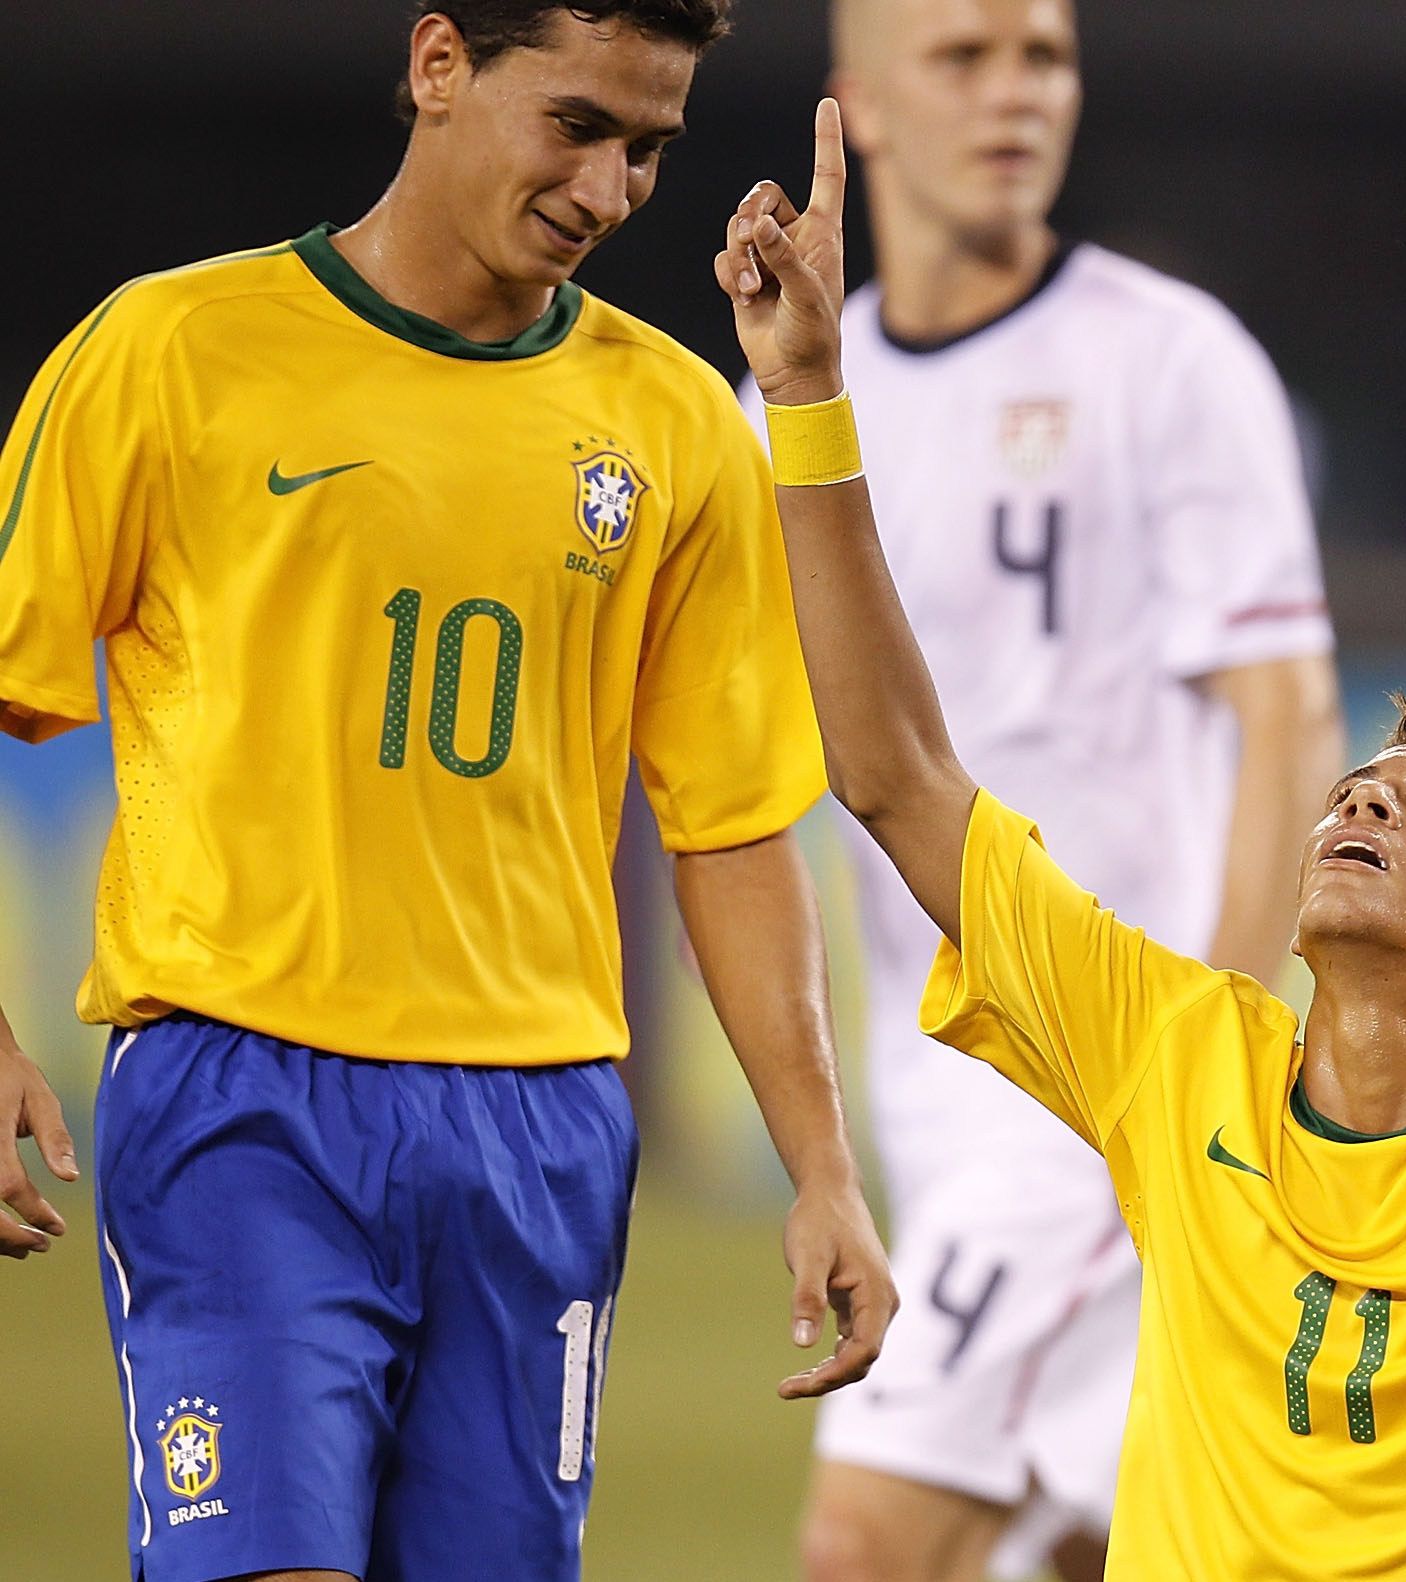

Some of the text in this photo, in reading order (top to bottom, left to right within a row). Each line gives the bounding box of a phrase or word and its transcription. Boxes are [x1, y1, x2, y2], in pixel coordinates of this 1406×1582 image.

[599, 490, 622, 507] CBF
[989, 502, 1063, 637] 4
[379, 587, 522, 778] 10
[928, 1238, 1006, 1373] 4
[1285, 1271, 1391, 1444] 11
[168, 1499, 229, 1526] BRASIL
[180, 1448, 199, 1461] CBF
